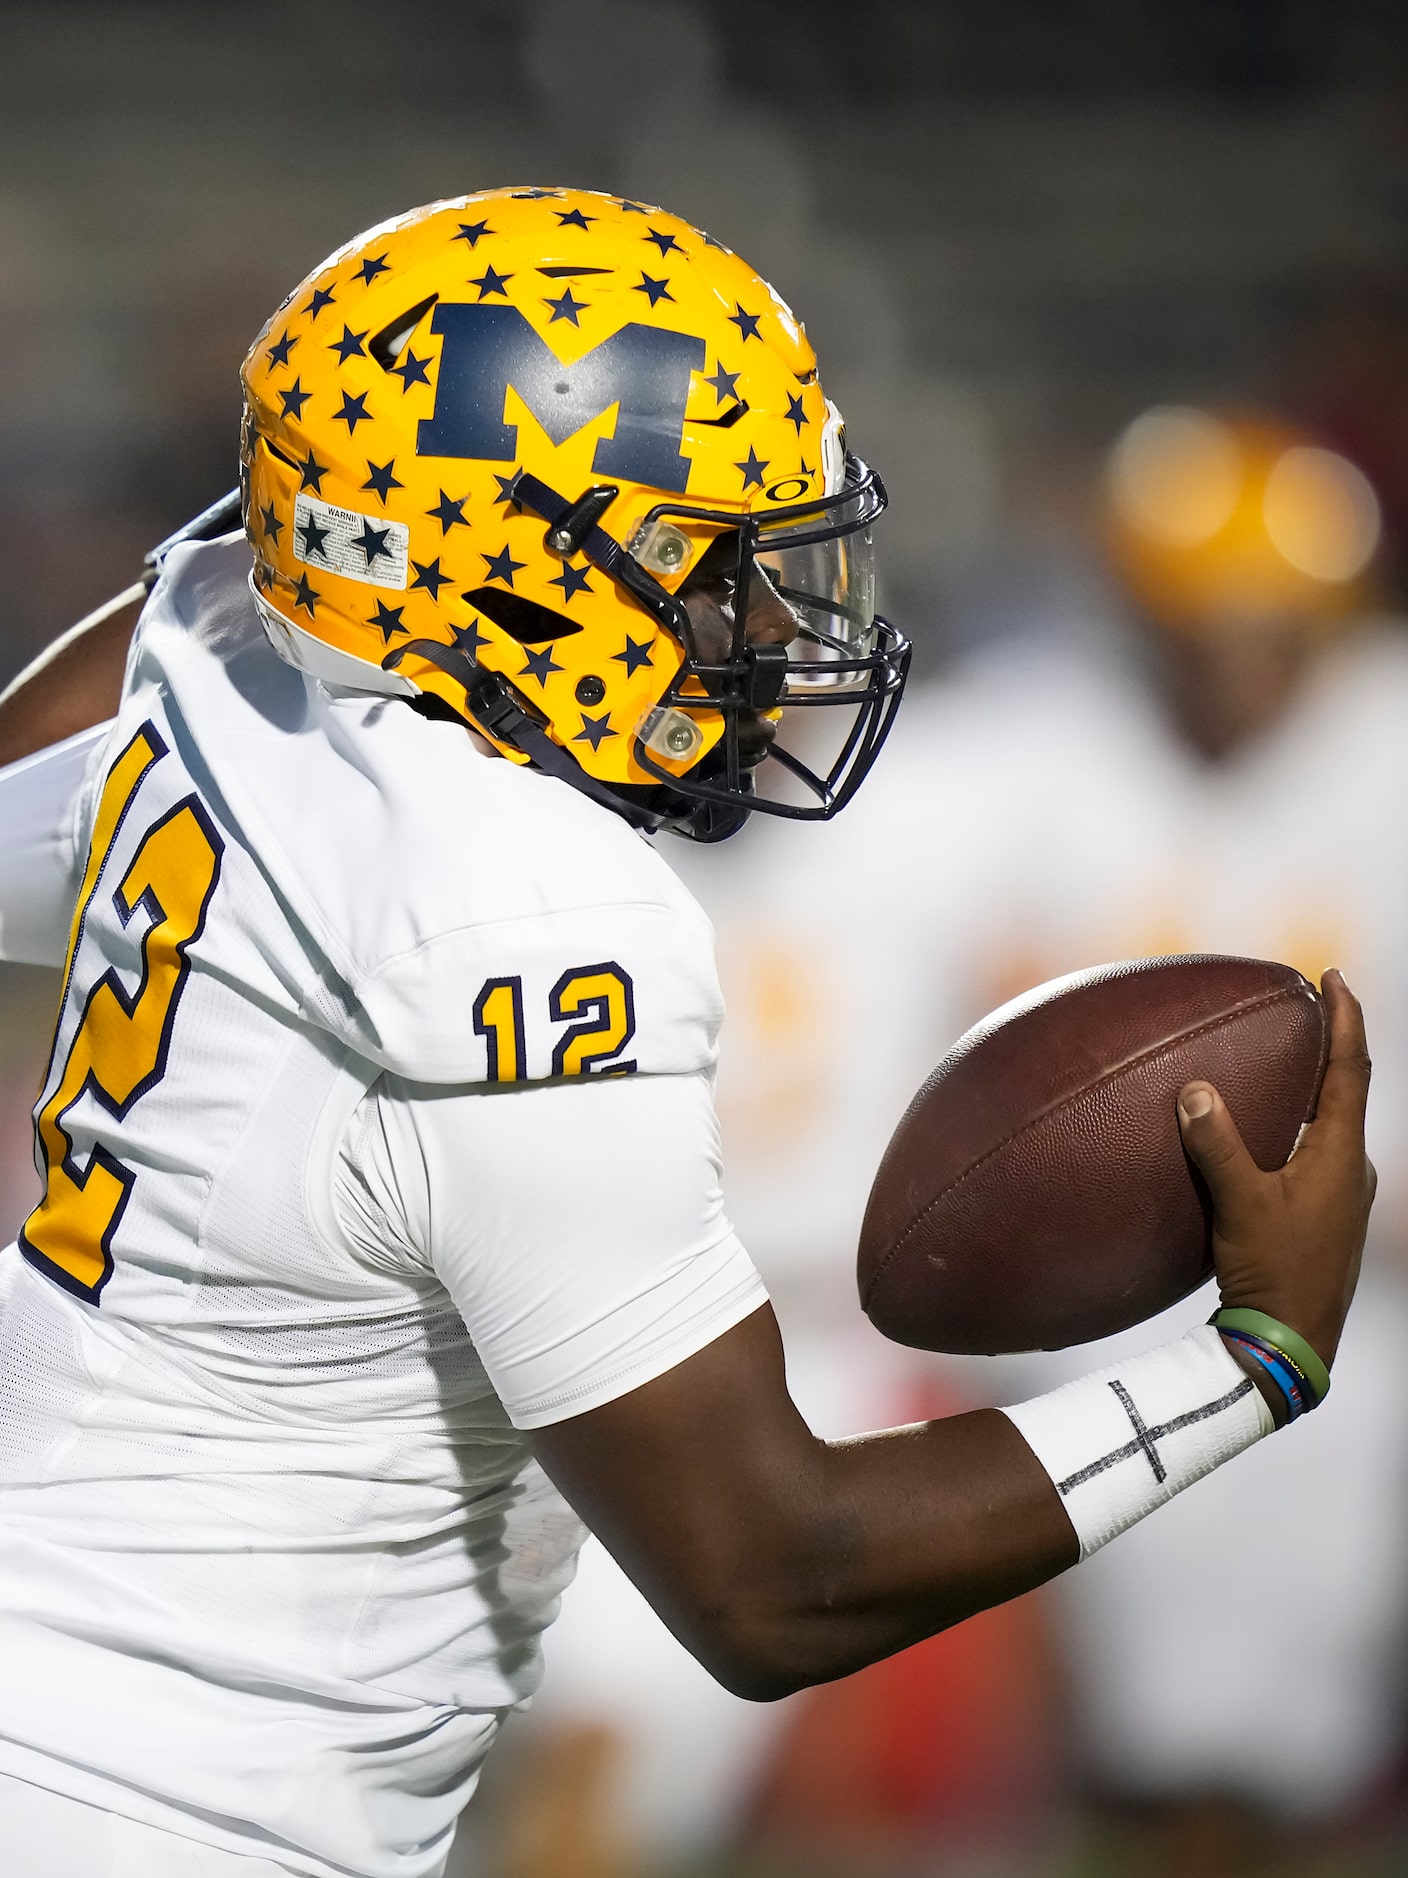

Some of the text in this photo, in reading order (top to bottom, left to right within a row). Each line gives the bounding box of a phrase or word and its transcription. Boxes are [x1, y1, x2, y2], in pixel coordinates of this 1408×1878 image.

[416, 303, 706, 494] M
[328, 507, 357, 523] WARNI
[472, 961, 638, 1082] 12
